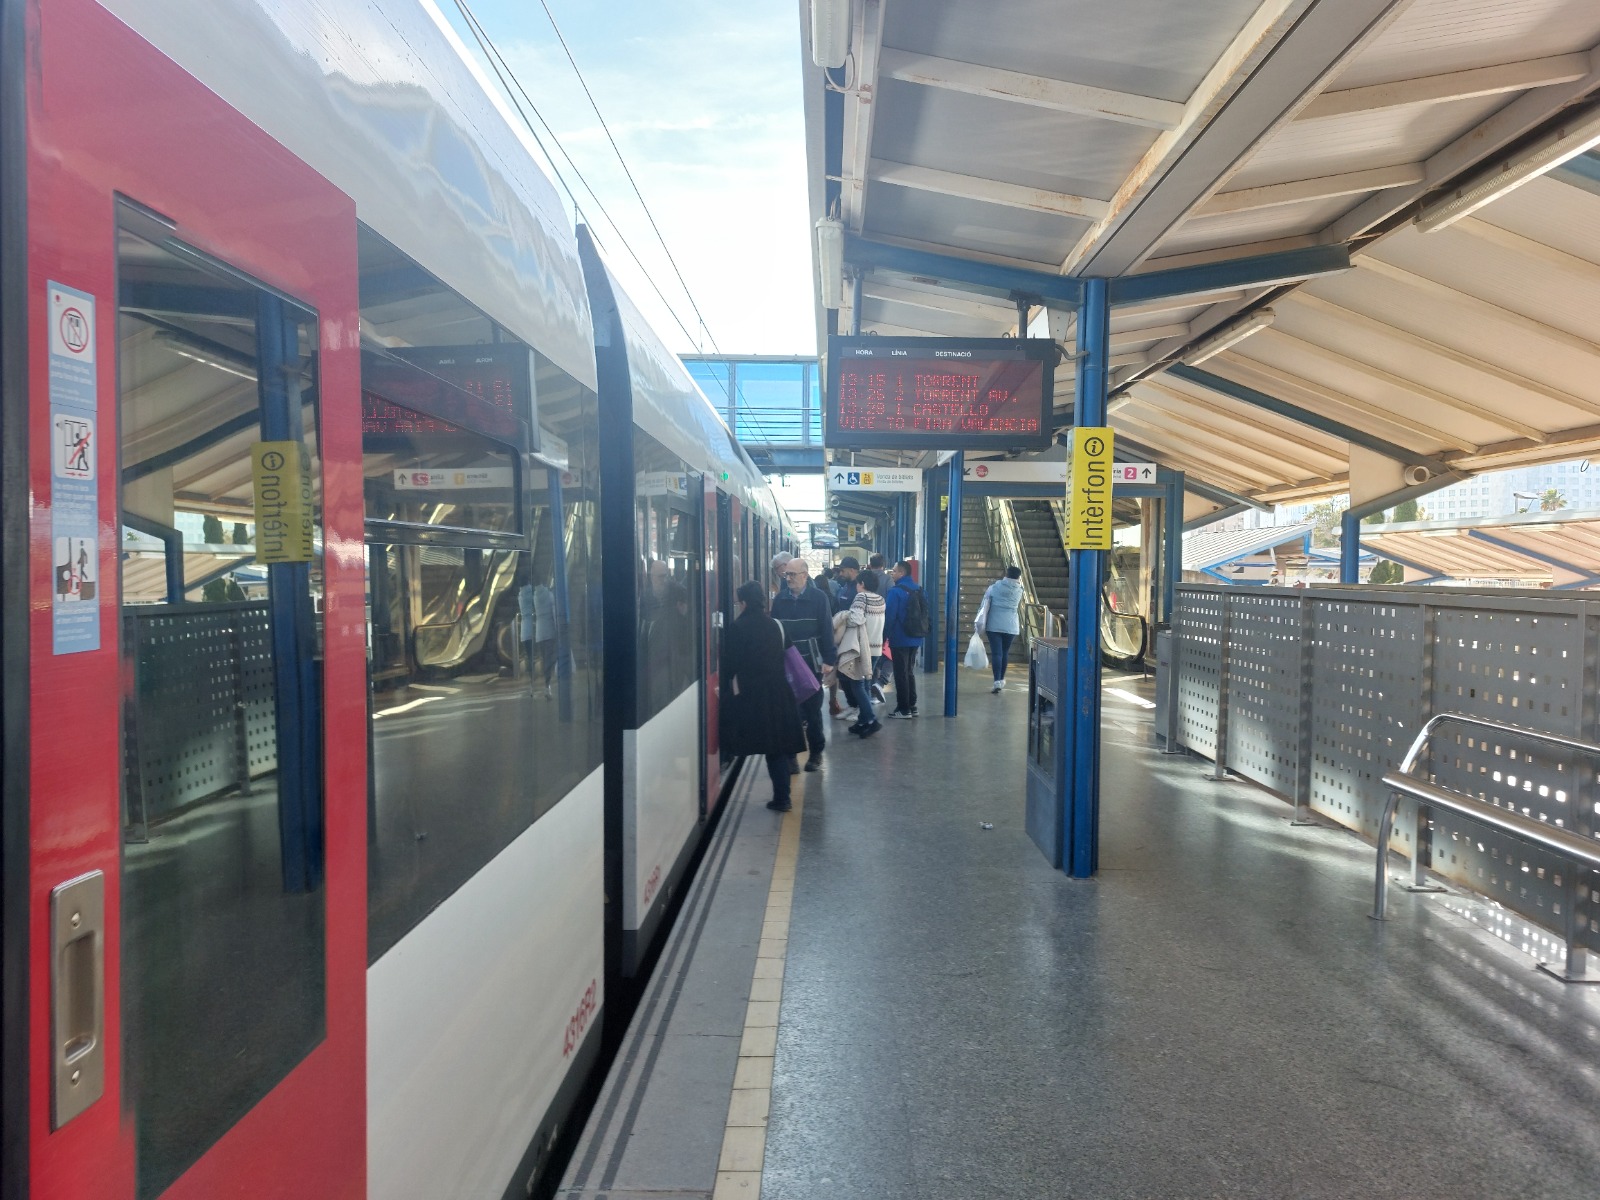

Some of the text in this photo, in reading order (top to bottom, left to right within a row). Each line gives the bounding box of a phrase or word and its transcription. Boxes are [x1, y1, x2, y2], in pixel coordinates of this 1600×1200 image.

[935, 350, 972, 358] DESTINACIÓ
[913, 374, 980, 388] TORRENT
[914, 389, 980, 402] TORRENT
[913, 403, 989, 416] CASTELLO
[914, 417, 952, 430] FIRA
[961, 418, 1038, 431] VALENCIA
[1127, 468, 1134, 478] 2
[1080, 461, 1105, 545] Intèrfon
